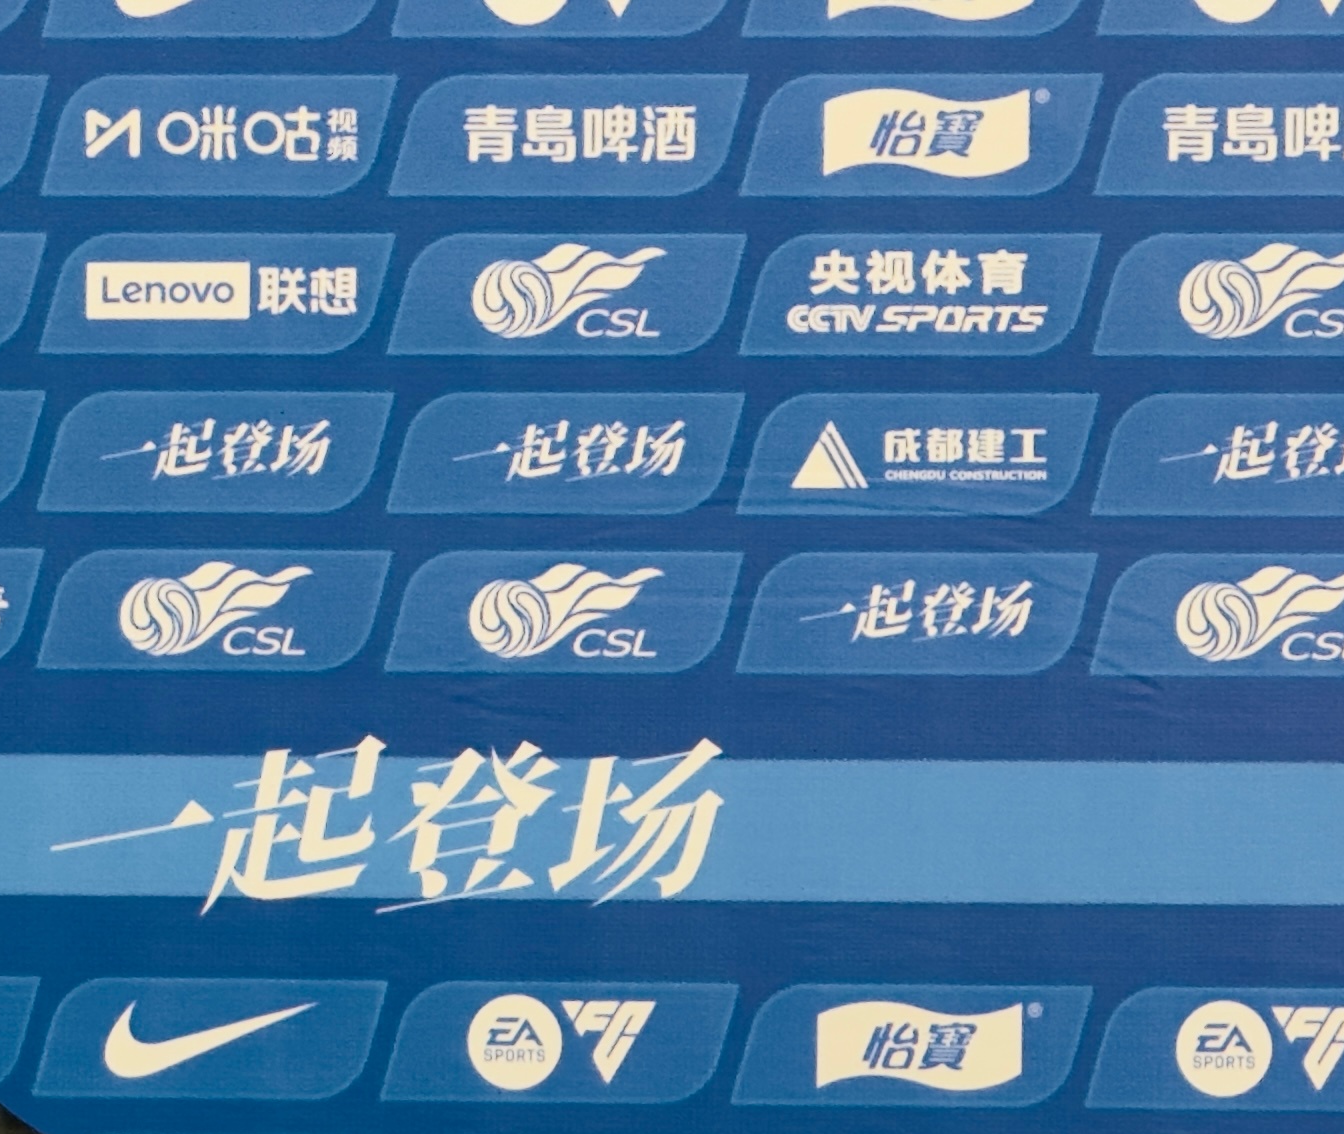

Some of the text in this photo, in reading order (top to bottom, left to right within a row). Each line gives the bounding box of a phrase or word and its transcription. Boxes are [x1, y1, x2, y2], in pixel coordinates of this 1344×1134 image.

[869, 109, 985, 158] 怡寶
[809, 248, 1028, 295] 央视体育
[101, 266, 358, 316] Lenovo 联想
[576, 308, 660, 338] CSL
[786, 304, 1048, 333] CCTV SPORTS
[101, 417, 331, 479] 一起登场
[453, 419, 686, 481] 一起登场
[884, 427, 1047, 463] 成都建工
[884, 469, 1047, 481] CHENGDU CONSTRUCTION
[799, 579, 1033, 641] 一起登场
[222, 626, 306, 656] CSL
[572, 628, 657, 658] CSL
[49, 734, 726, 915] 一起登场
[486, 1017, 543, 1047] EA
[862, 1022, 977, 1071] 怡寶
[1195, 1023, 1252, 1053] EA
[483, 1047, 546, 1063] SPORTS
[1192, 1054, 1256, 1070] SPORTS
